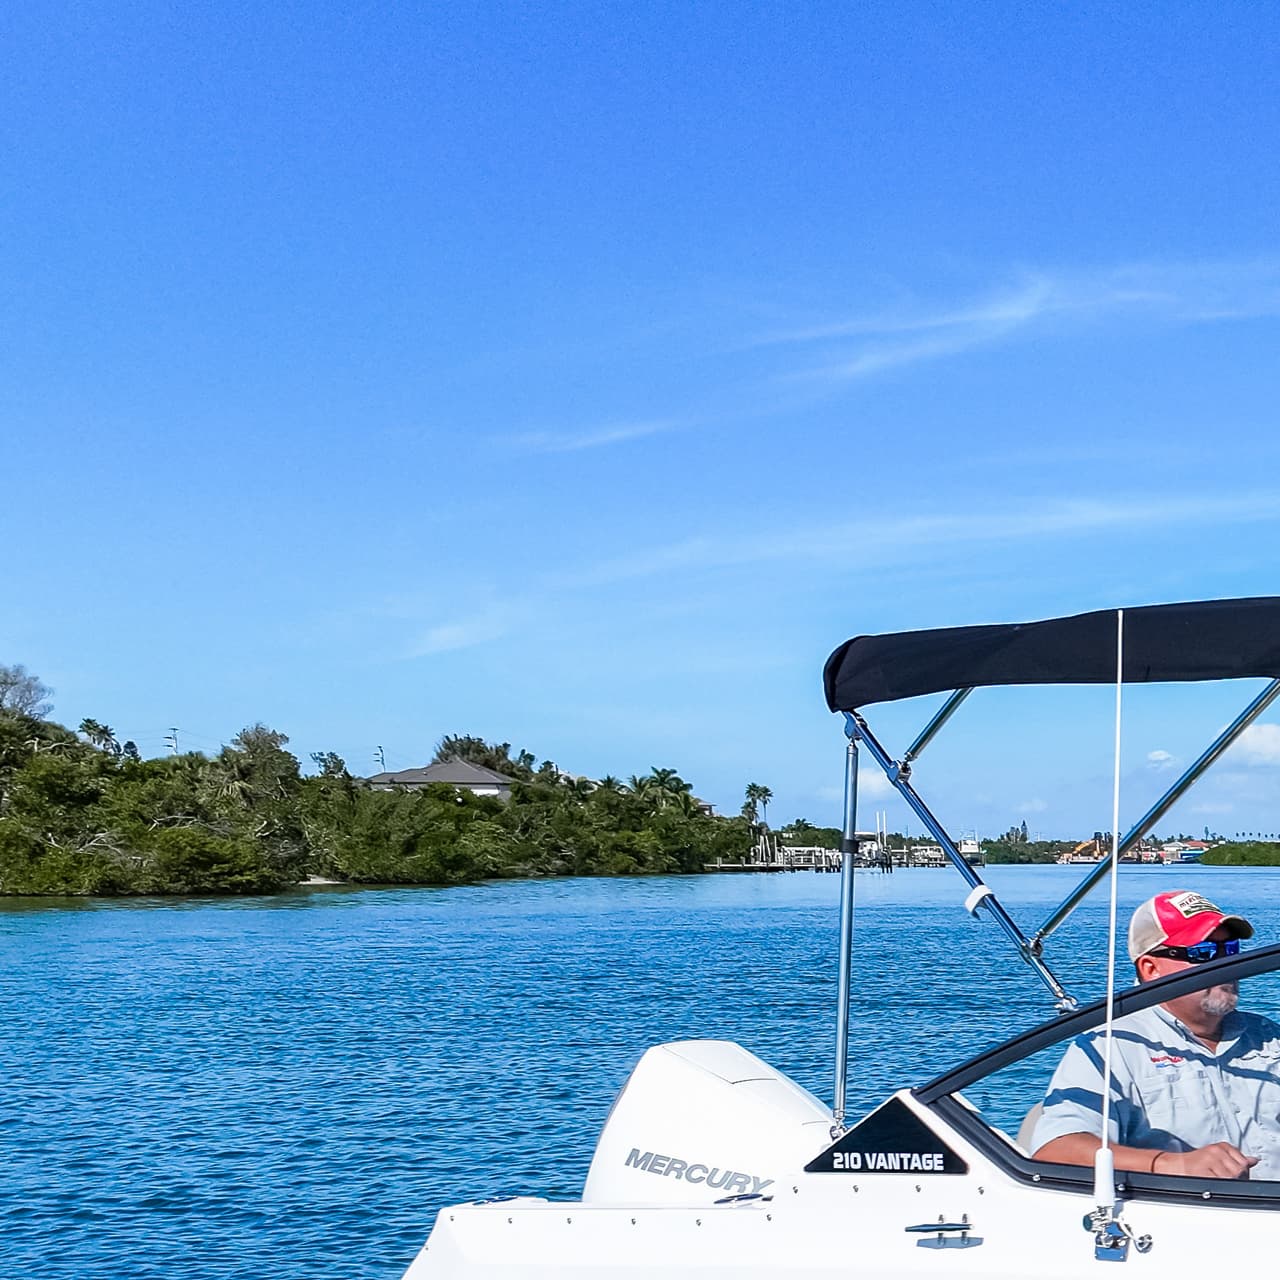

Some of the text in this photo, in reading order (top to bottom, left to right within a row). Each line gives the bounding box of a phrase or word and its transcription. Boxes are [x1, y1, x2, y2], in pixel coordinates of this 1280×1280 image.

[625, 1148, 775, 1194] MERCURY
[833, 1152, 945, 1171] 210 VANTAGE
